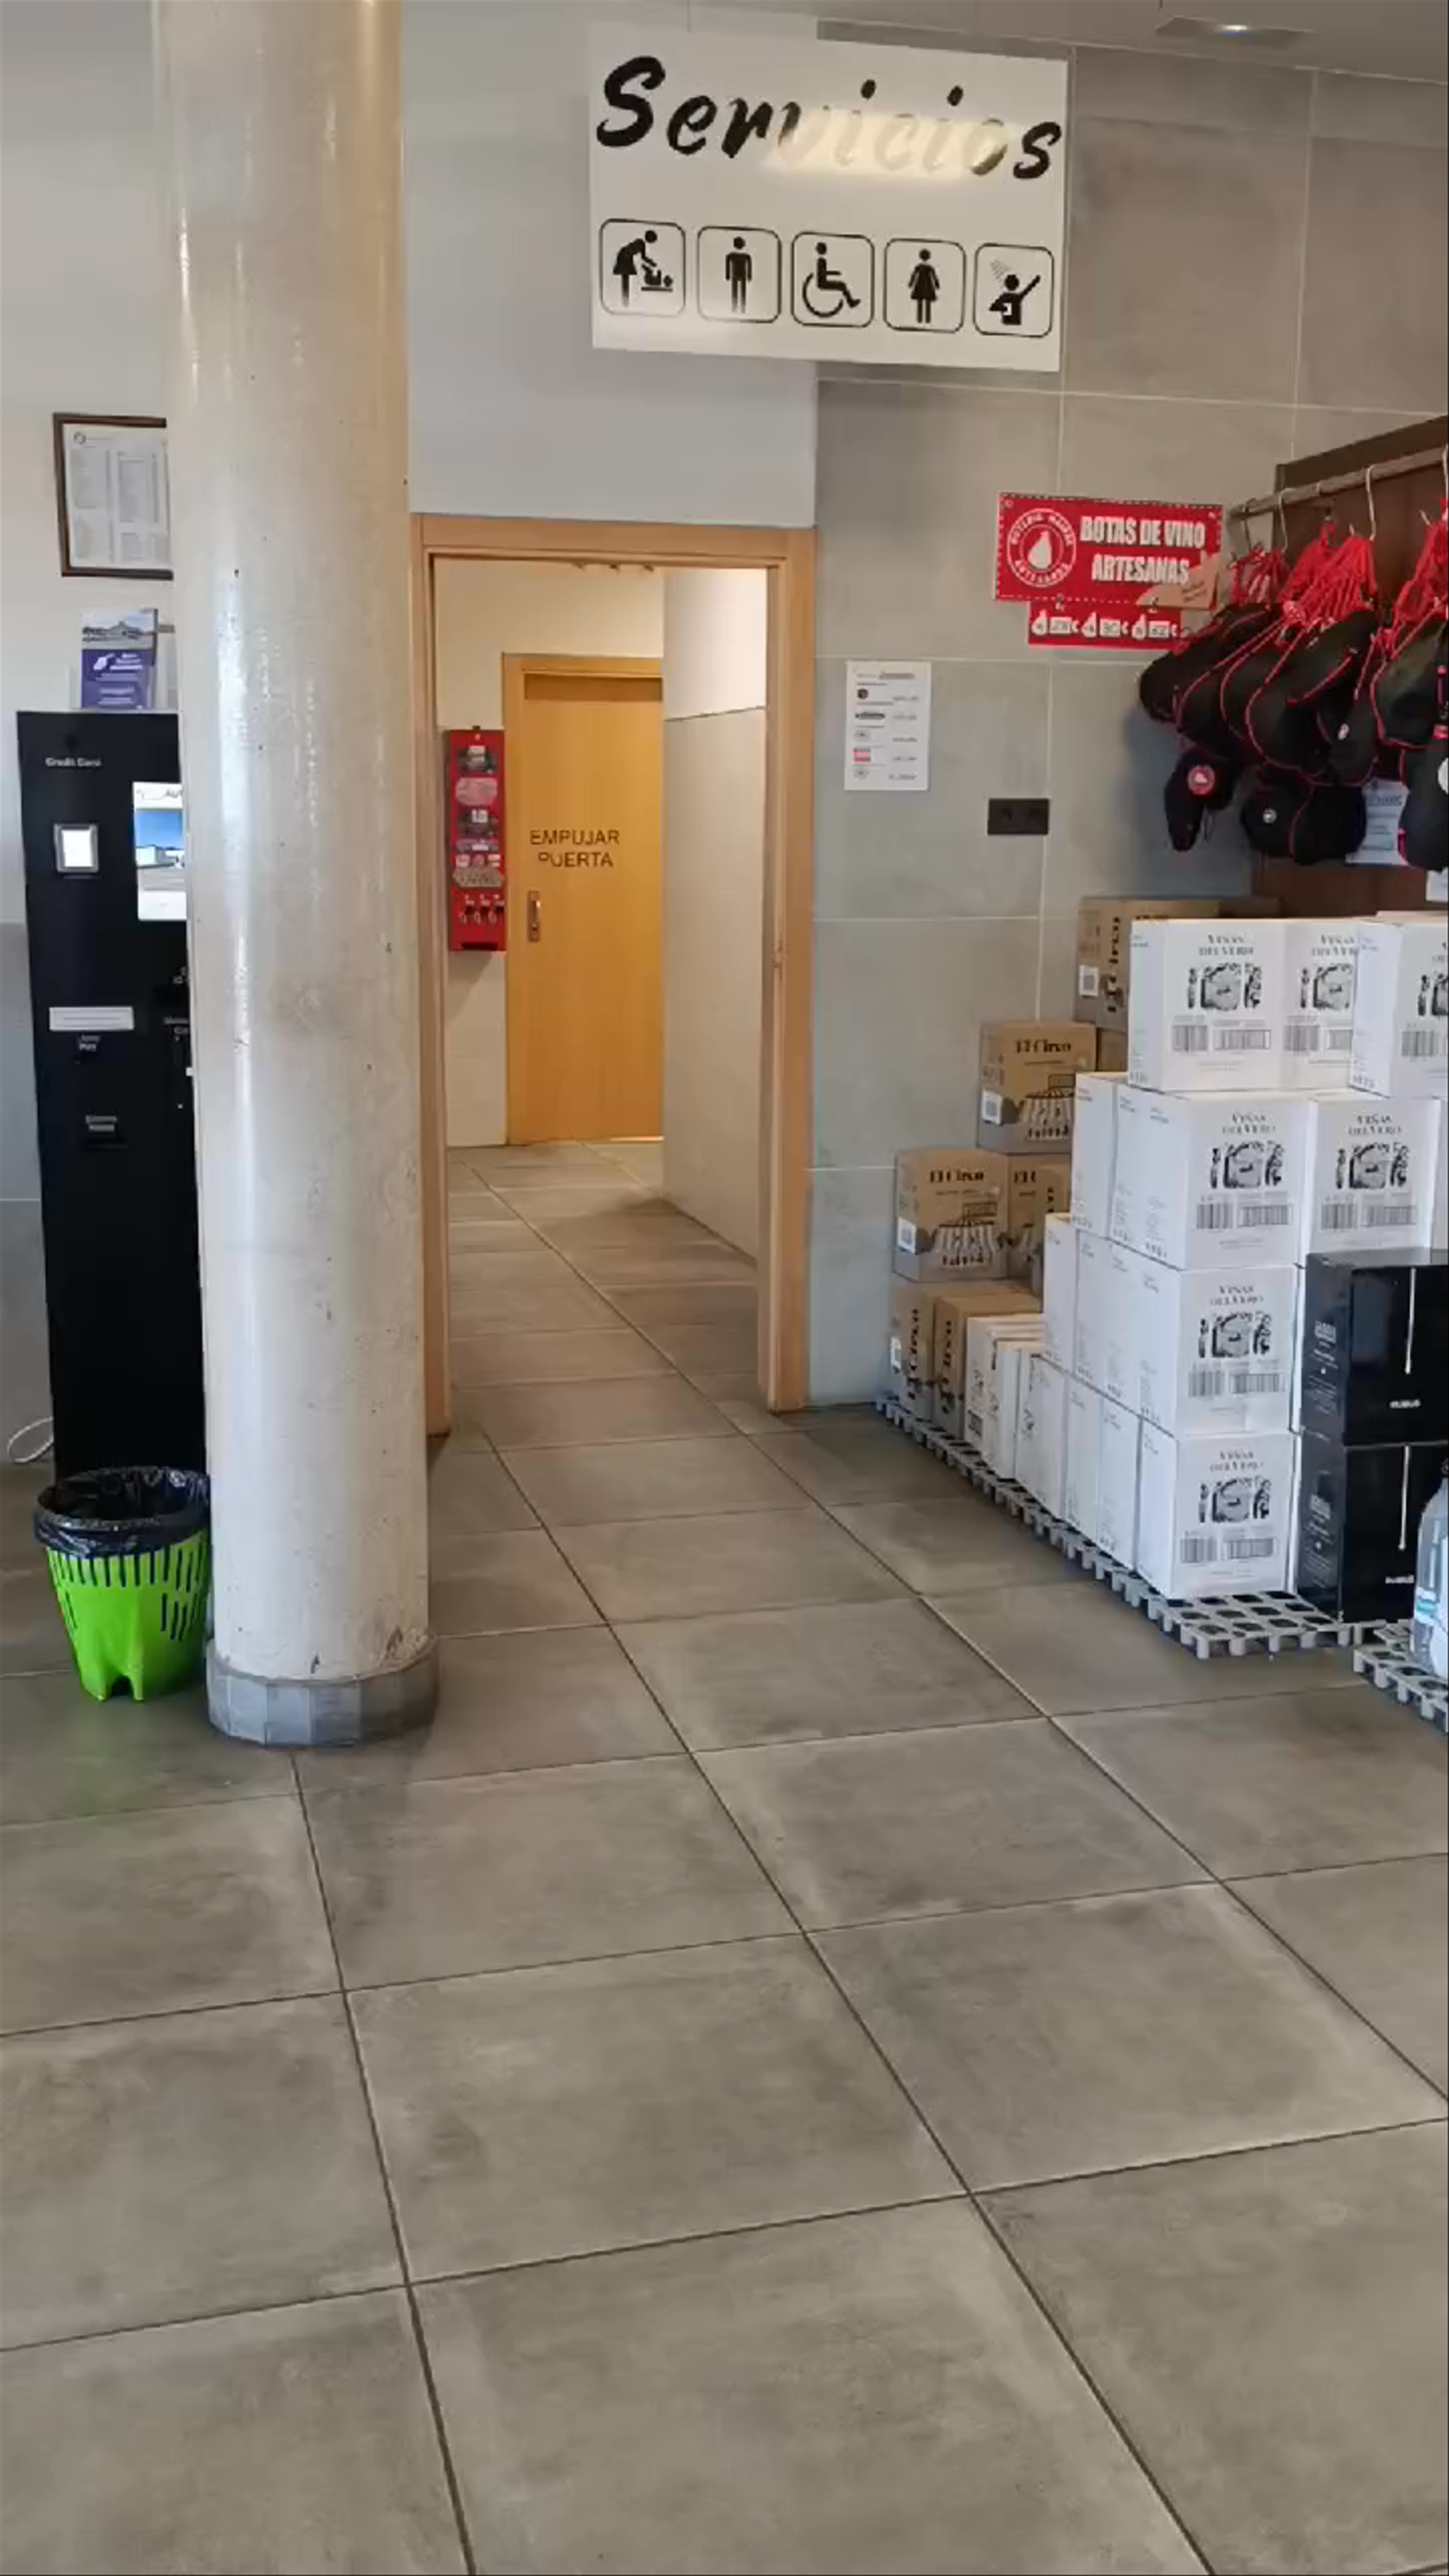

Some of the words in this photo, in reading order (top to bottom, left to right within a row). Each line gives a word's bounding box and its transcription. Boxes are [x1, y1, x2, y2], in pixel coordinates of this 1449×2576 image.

[596, 55, 1061, 180] Servicios
[1080, 516, 1137, 546] BOTAS
[1140, 520, 1161, 546] DE
[1164, 520, 1206, 549] VINO
[1092, 554, 1190, 585] ARTESANAS
[530, 829, 620, 845] EMPUJAR
[538, 852, 614, 867] PUERTA
